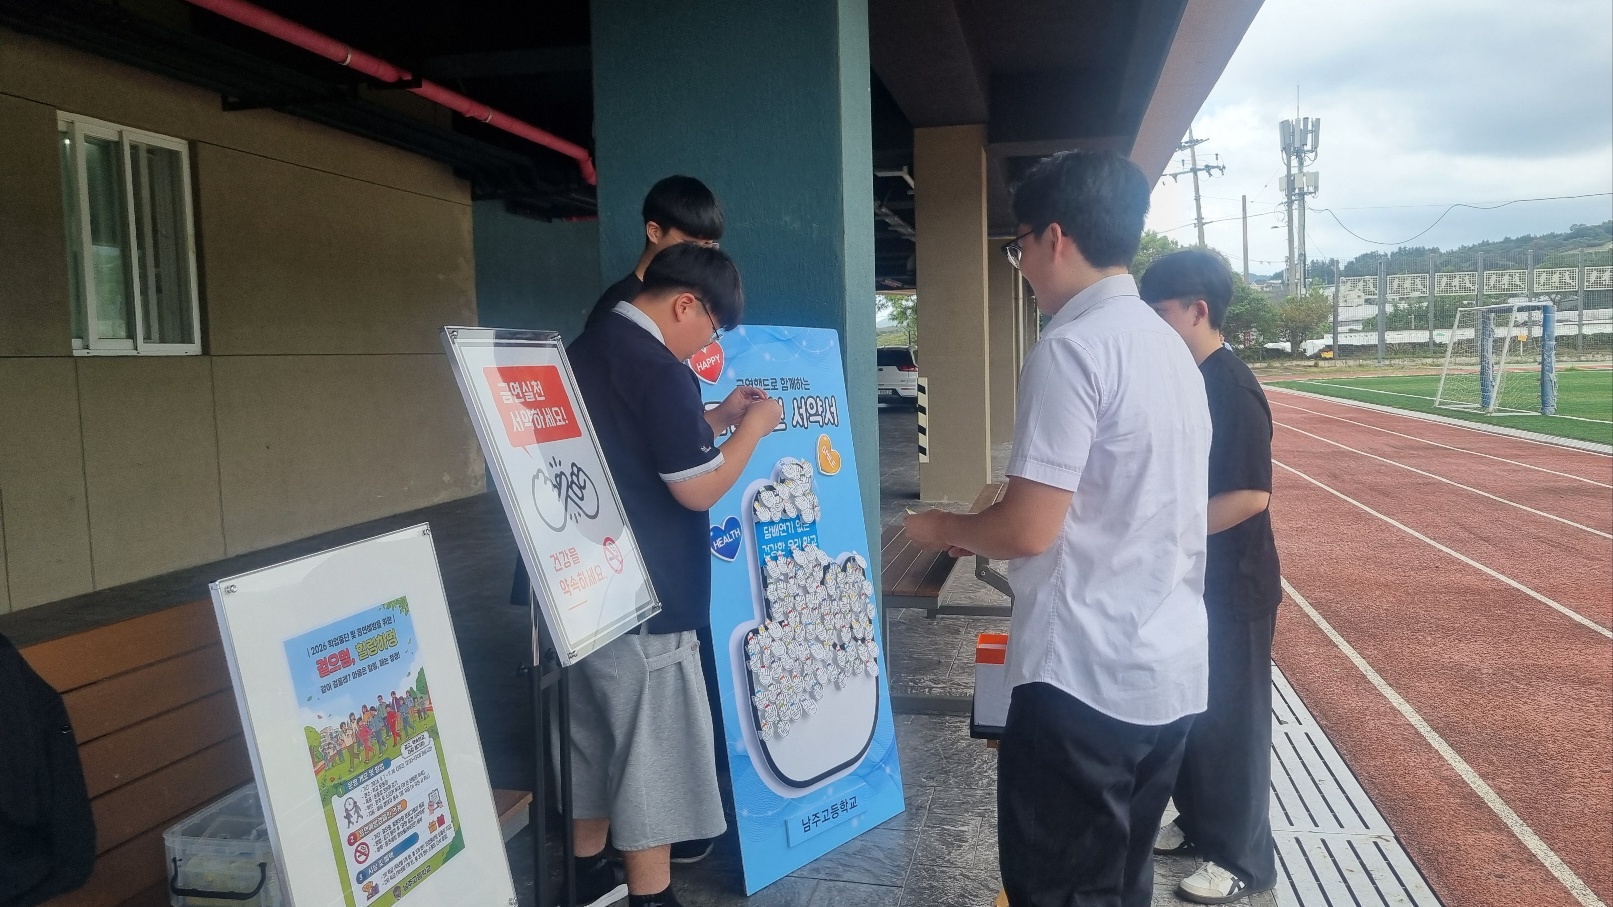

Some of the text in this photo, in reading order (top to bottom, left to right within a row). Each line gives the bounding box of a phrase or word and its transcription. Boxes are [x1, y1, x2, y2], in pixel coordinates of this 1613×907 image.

[696, 354, 721, 372] HAPPY
[498, 380, 545, 404] 금연실천
[780, 376, 810, 391] 함께하는
[510, 406, 569, 432] 서약하세요!
[792, 395, 839, 429] 서약서
[713, 528, 741, 550] HEALTH
[763, 521, 795, 539] 담배연기
[550, 546, 581, 573] 건강을
[559, 564, 608, 596] 약속하세요.
[310, 641, 328, 655] 2026
[355, 628, 399, 662] 힐링하멍
[801, 796, 858, 833] 남주고등학교
